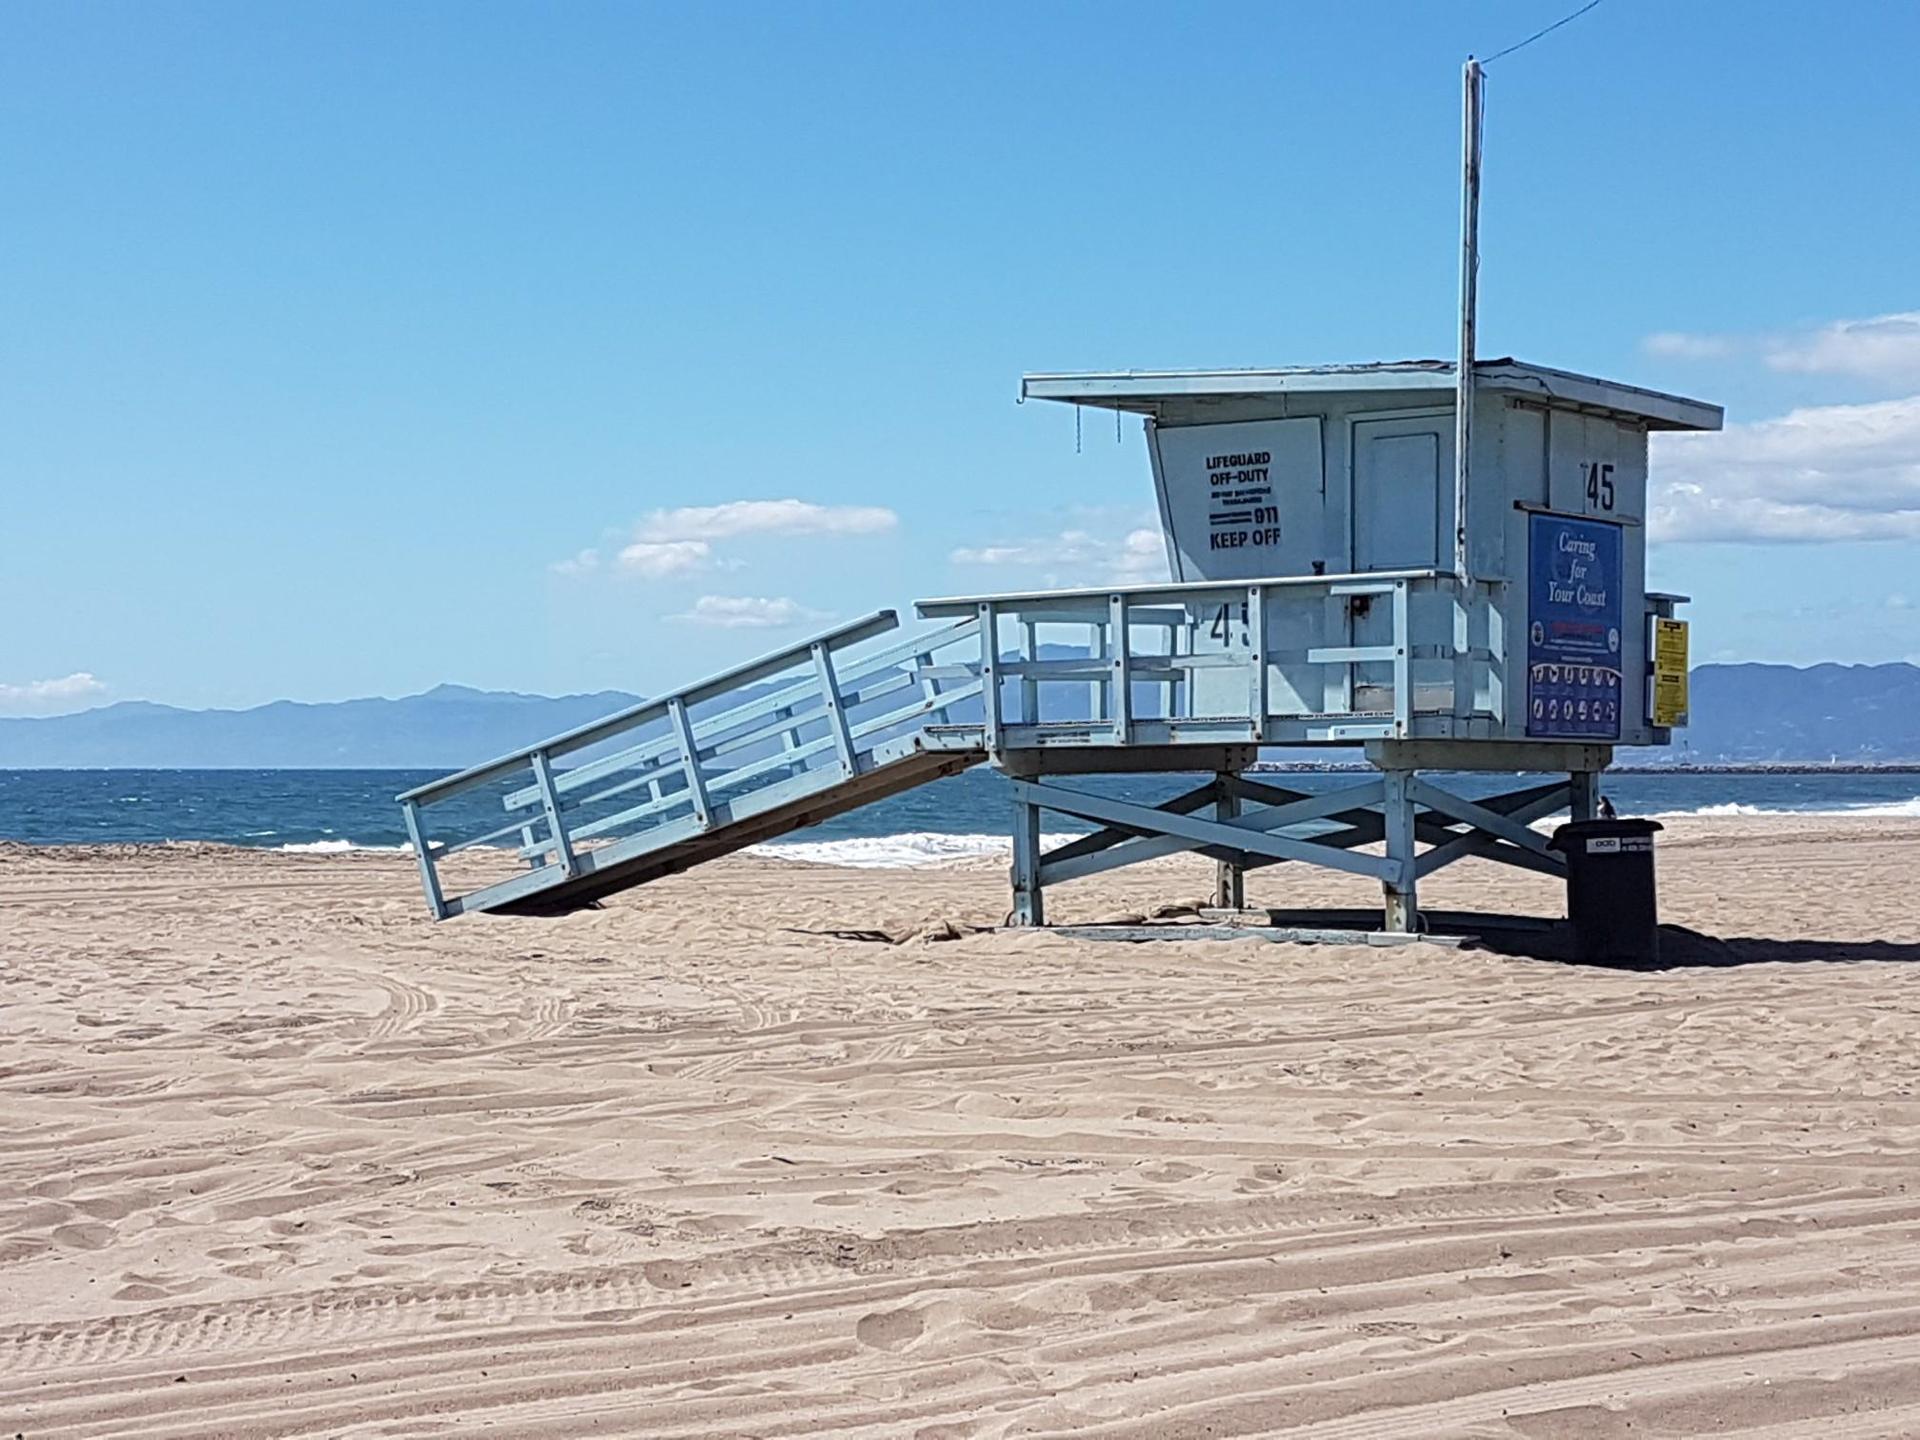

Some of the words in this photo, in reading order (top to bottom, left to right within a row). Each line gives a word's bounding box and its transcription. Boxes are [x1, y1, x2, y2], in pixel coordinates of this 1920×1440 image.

[1206, 452, 1271, 469] LIFEGUARD
[1210, 468, 1269, 486] OFF-DUTY
[1587, 462, 1614, 511] 45
[1210, 531, 1248, 550] KEEP
[1252, 528, 1281, 545] OFF
[1559, 531, 1597, 562] Caring
[1567, 558, 1588, 585] for
[1548, 581, 1575, 603] Your
[1576, 584, 1607, 607] Coast
